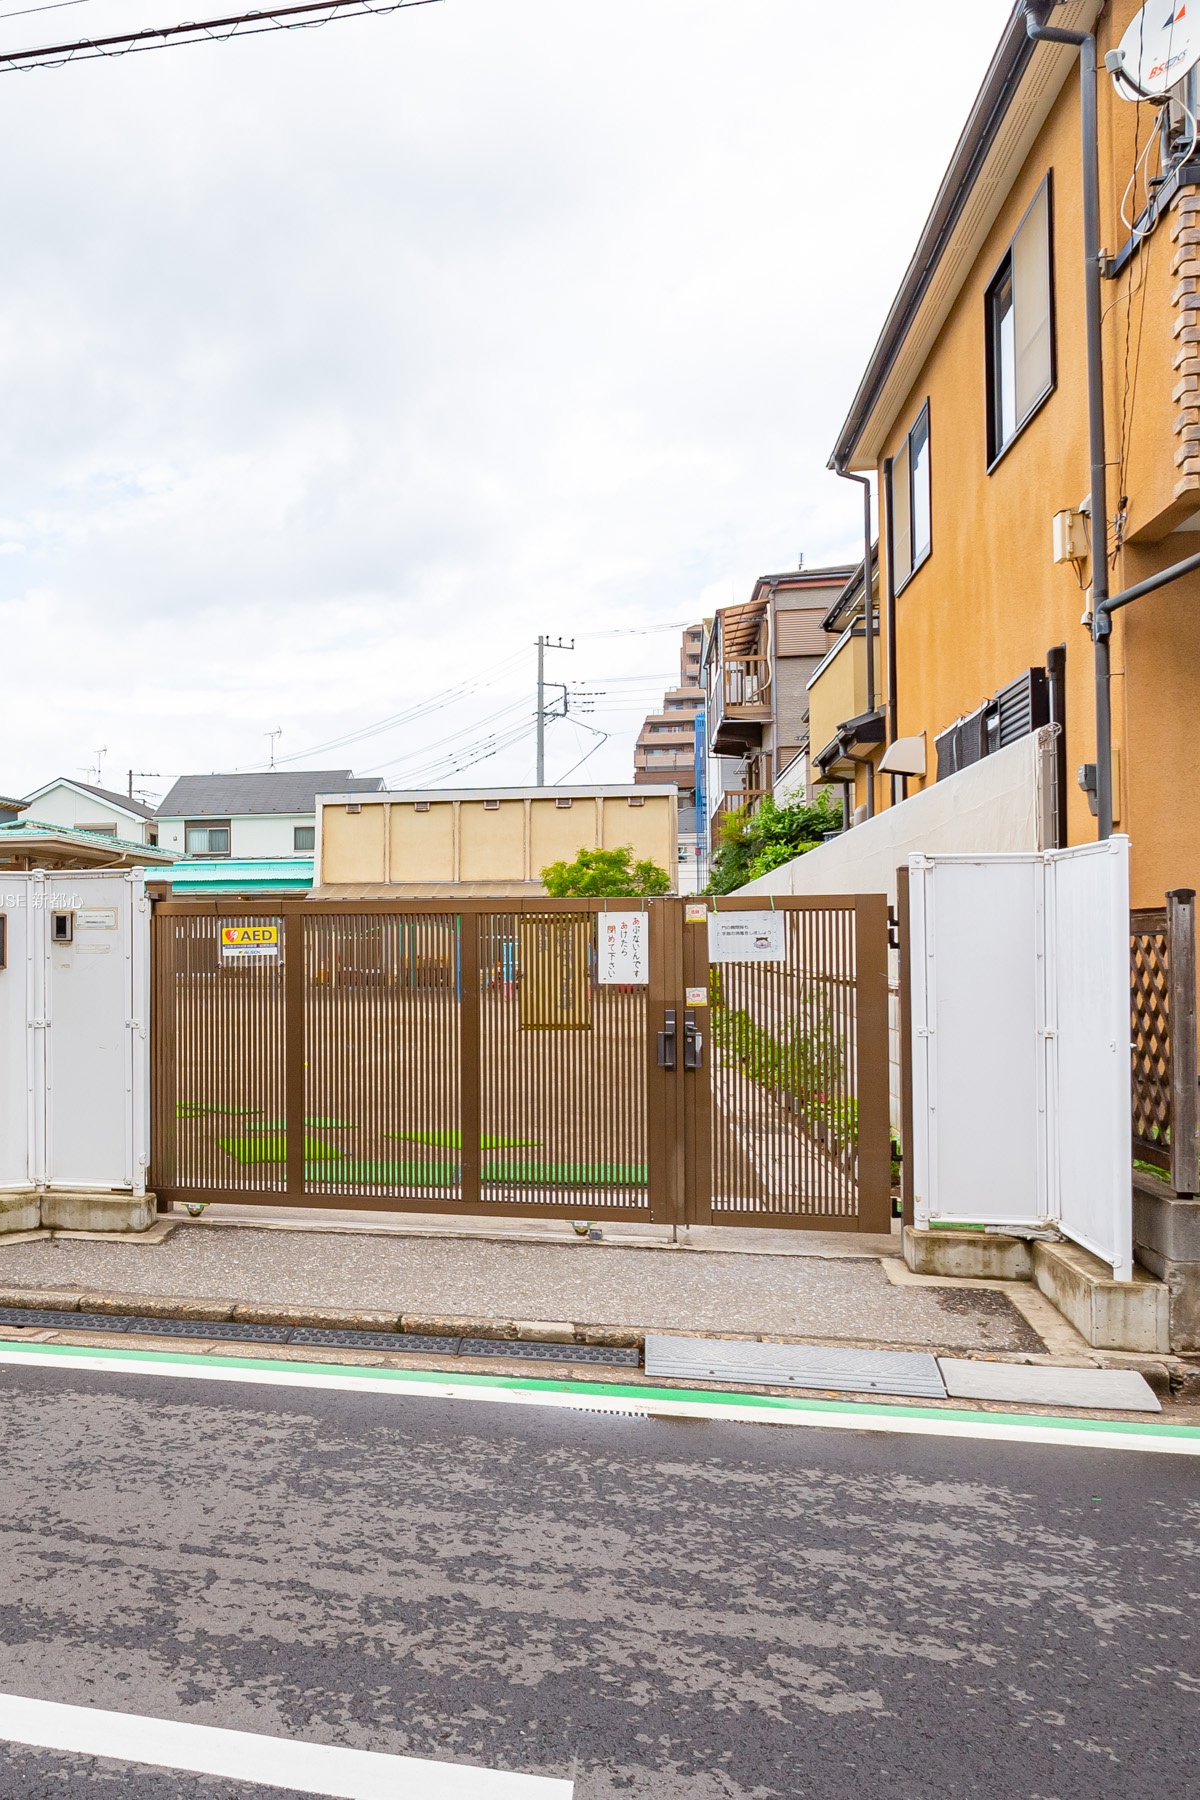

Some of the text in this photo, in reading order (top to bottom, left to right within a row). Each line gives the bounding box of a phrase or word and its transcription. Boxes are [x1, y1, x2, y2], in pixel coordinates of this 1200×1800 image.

[240, 929, 273, 942] AED
[607, 925, 616, 978] 閉めて下さい
[620, 921, 629, 957] あけたら
[632, 917, 641, 978] あぶないんです
